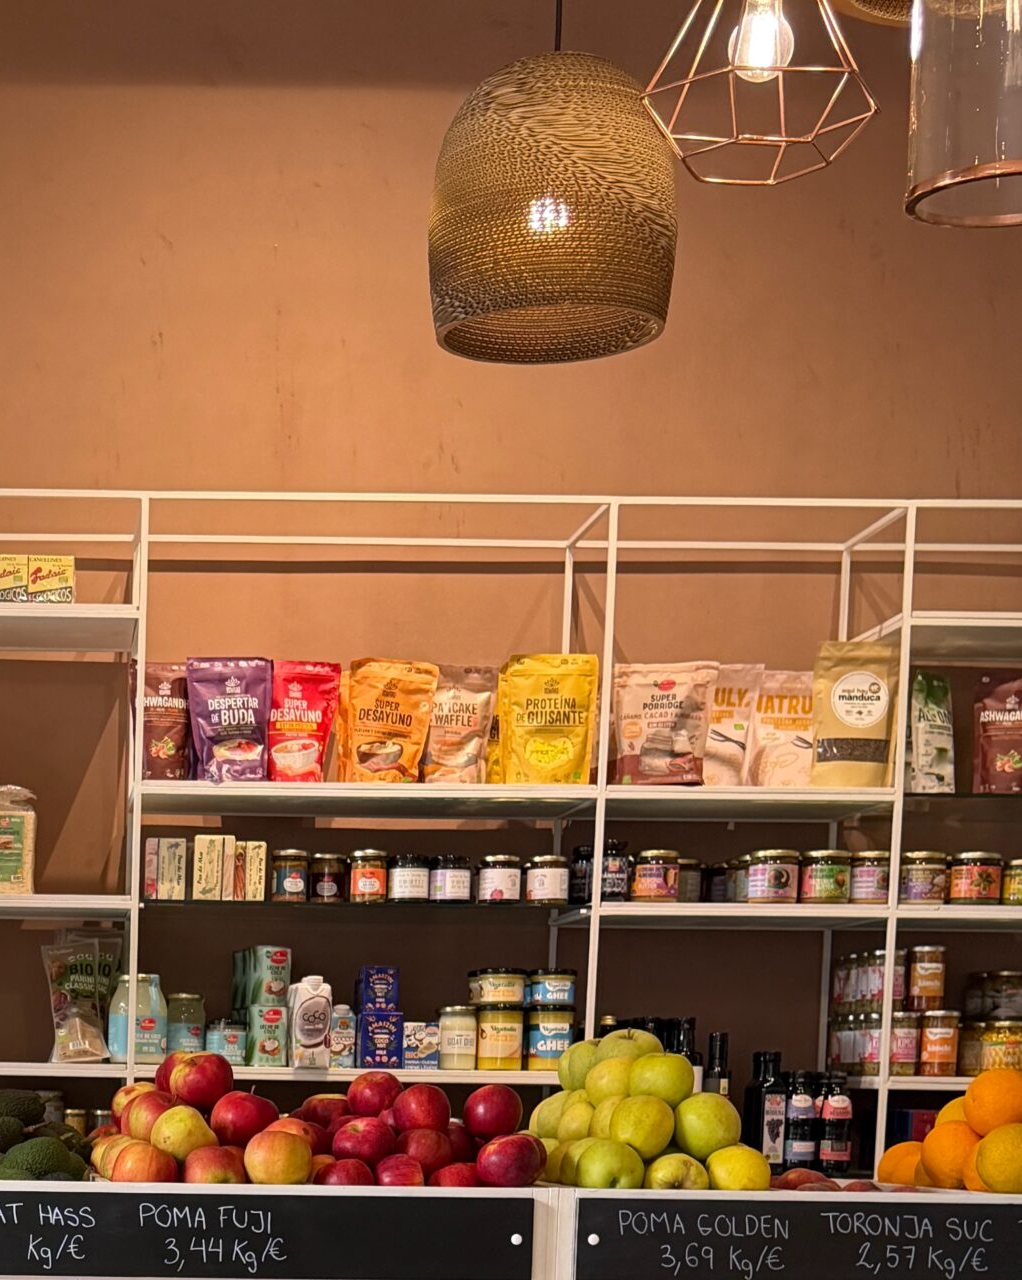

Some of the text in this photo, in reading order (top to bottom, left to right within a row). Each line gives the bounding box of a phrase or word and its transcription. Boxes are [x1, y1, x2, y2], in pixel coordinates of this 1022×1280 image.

[208, 697, 259, 710] DESPERTAR
[284, 698, 308, 709] SUPER
[374, 699, 400, 709] SUPER
[525, 696, 577, 710] PROTEÍNA
[650, 694, 677, 702] SUPER
[838, 693, 881, 701] manduca
[642, 701, 684, 711] PORRIDGE
[211, 709, 256, 725] DE BUDA
[271, 708, 322, 723] DESAYUNO
[358, 708, 413, 727] DESAYUNO
[435, 715, 473, 727] WAFFLE
[516, 711, 584, 725] DE GUISANTE
[70, 963, 94, 974] BIO
[39, 1203, 96, 1228] HASS
[139, 1203, 272, 1234] POMA FUJI
[619, 1210, 789, 1240] POMA GOLDEN
[820, 1212, 994, 1242] TORONJA SUC
[164, 1237, 223, 1272] 3,44
[660, 1242, 713, 1276] 3,69
[856, 1242, 915, 1274] 2,57
